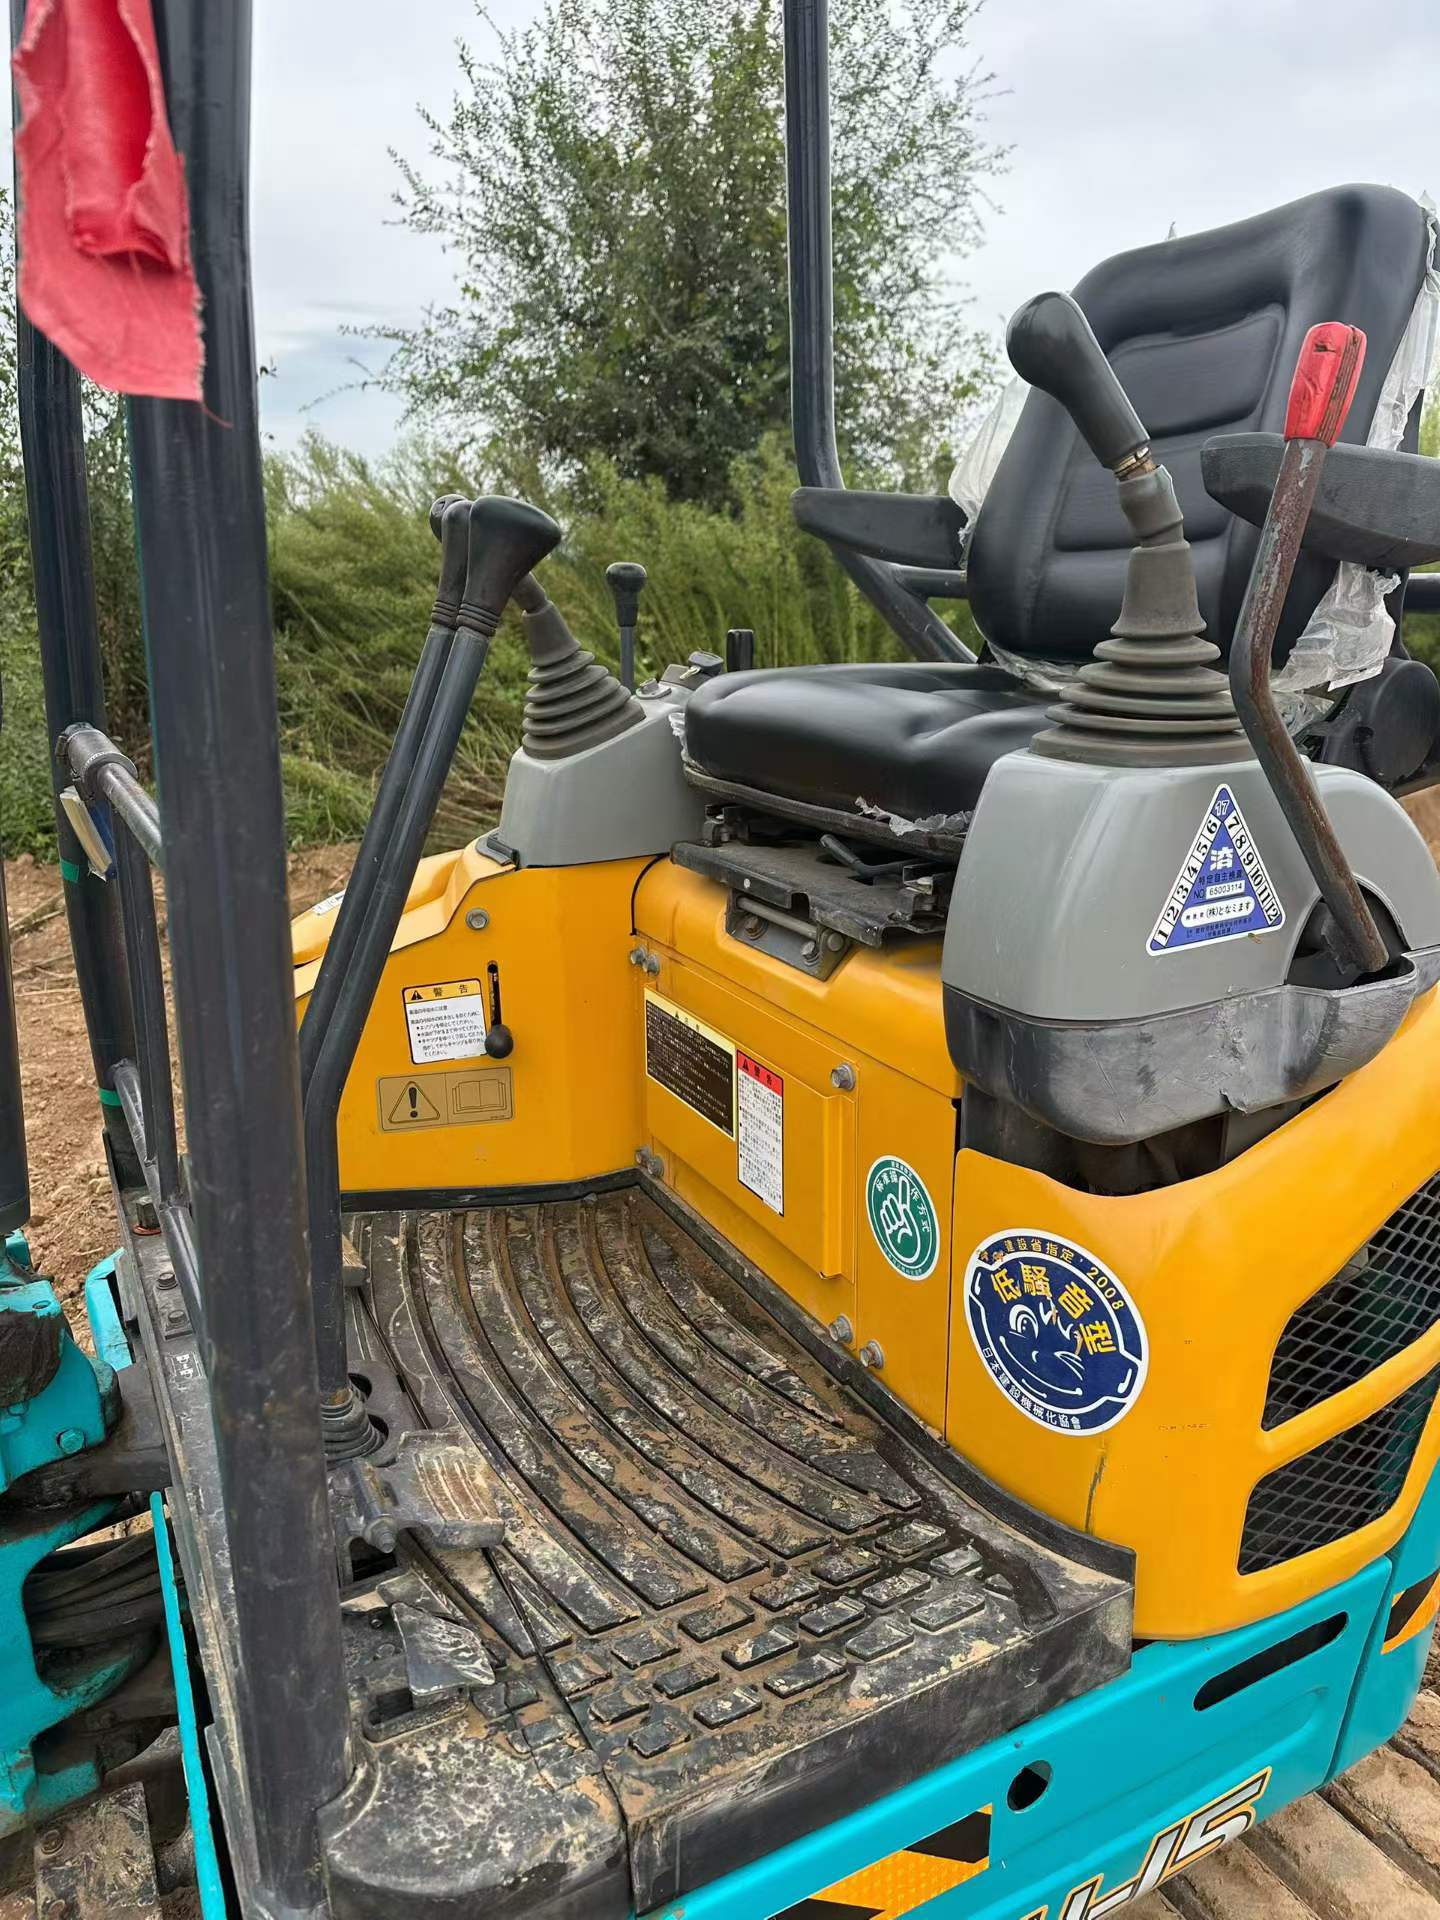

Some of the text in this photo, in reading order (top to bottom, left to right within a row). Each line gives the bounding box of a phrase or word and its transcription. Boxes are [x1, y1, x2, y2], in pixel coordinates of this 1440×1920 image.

[1214, 800, 1230, 816] 17
[1158, 819, 1218, 938] 1 2 3 4 5 6
[1227, 816, 1279, 922] 7 8 9 10 11 12
[1004, 1238, 1125, 1310] 建設省指定 2008
